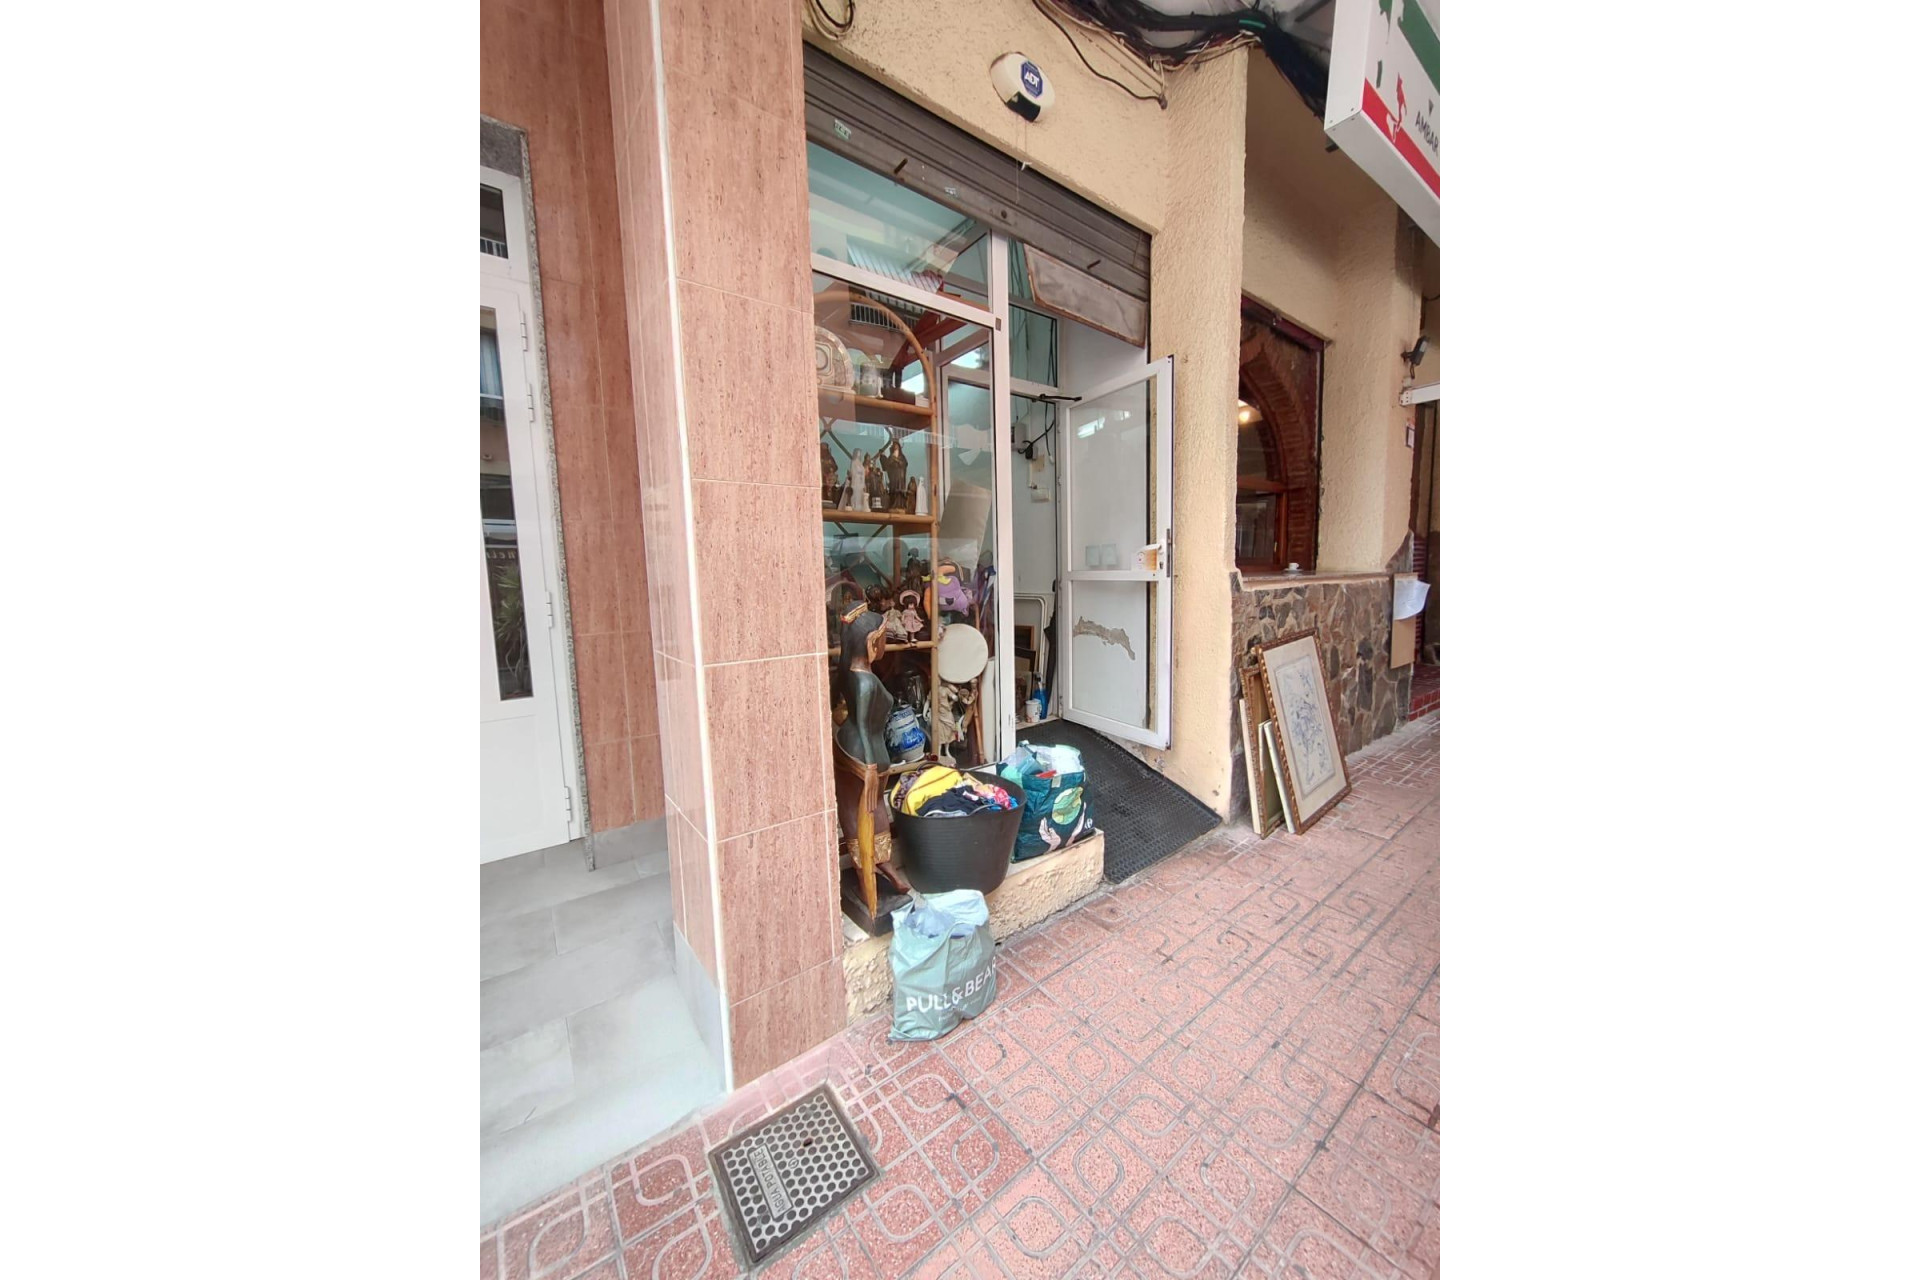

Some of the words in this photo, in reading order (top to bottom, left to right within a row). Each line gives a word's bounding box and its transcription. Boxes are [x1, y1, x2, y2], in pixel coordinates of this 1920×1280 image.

[1024, 71, 1040, 87] ADT
[1415, 110, 1439, 156] AMBAR
[753, 1148, 776, 1189] POTABLE
[770, 1187, 786, 1213] AGUA
